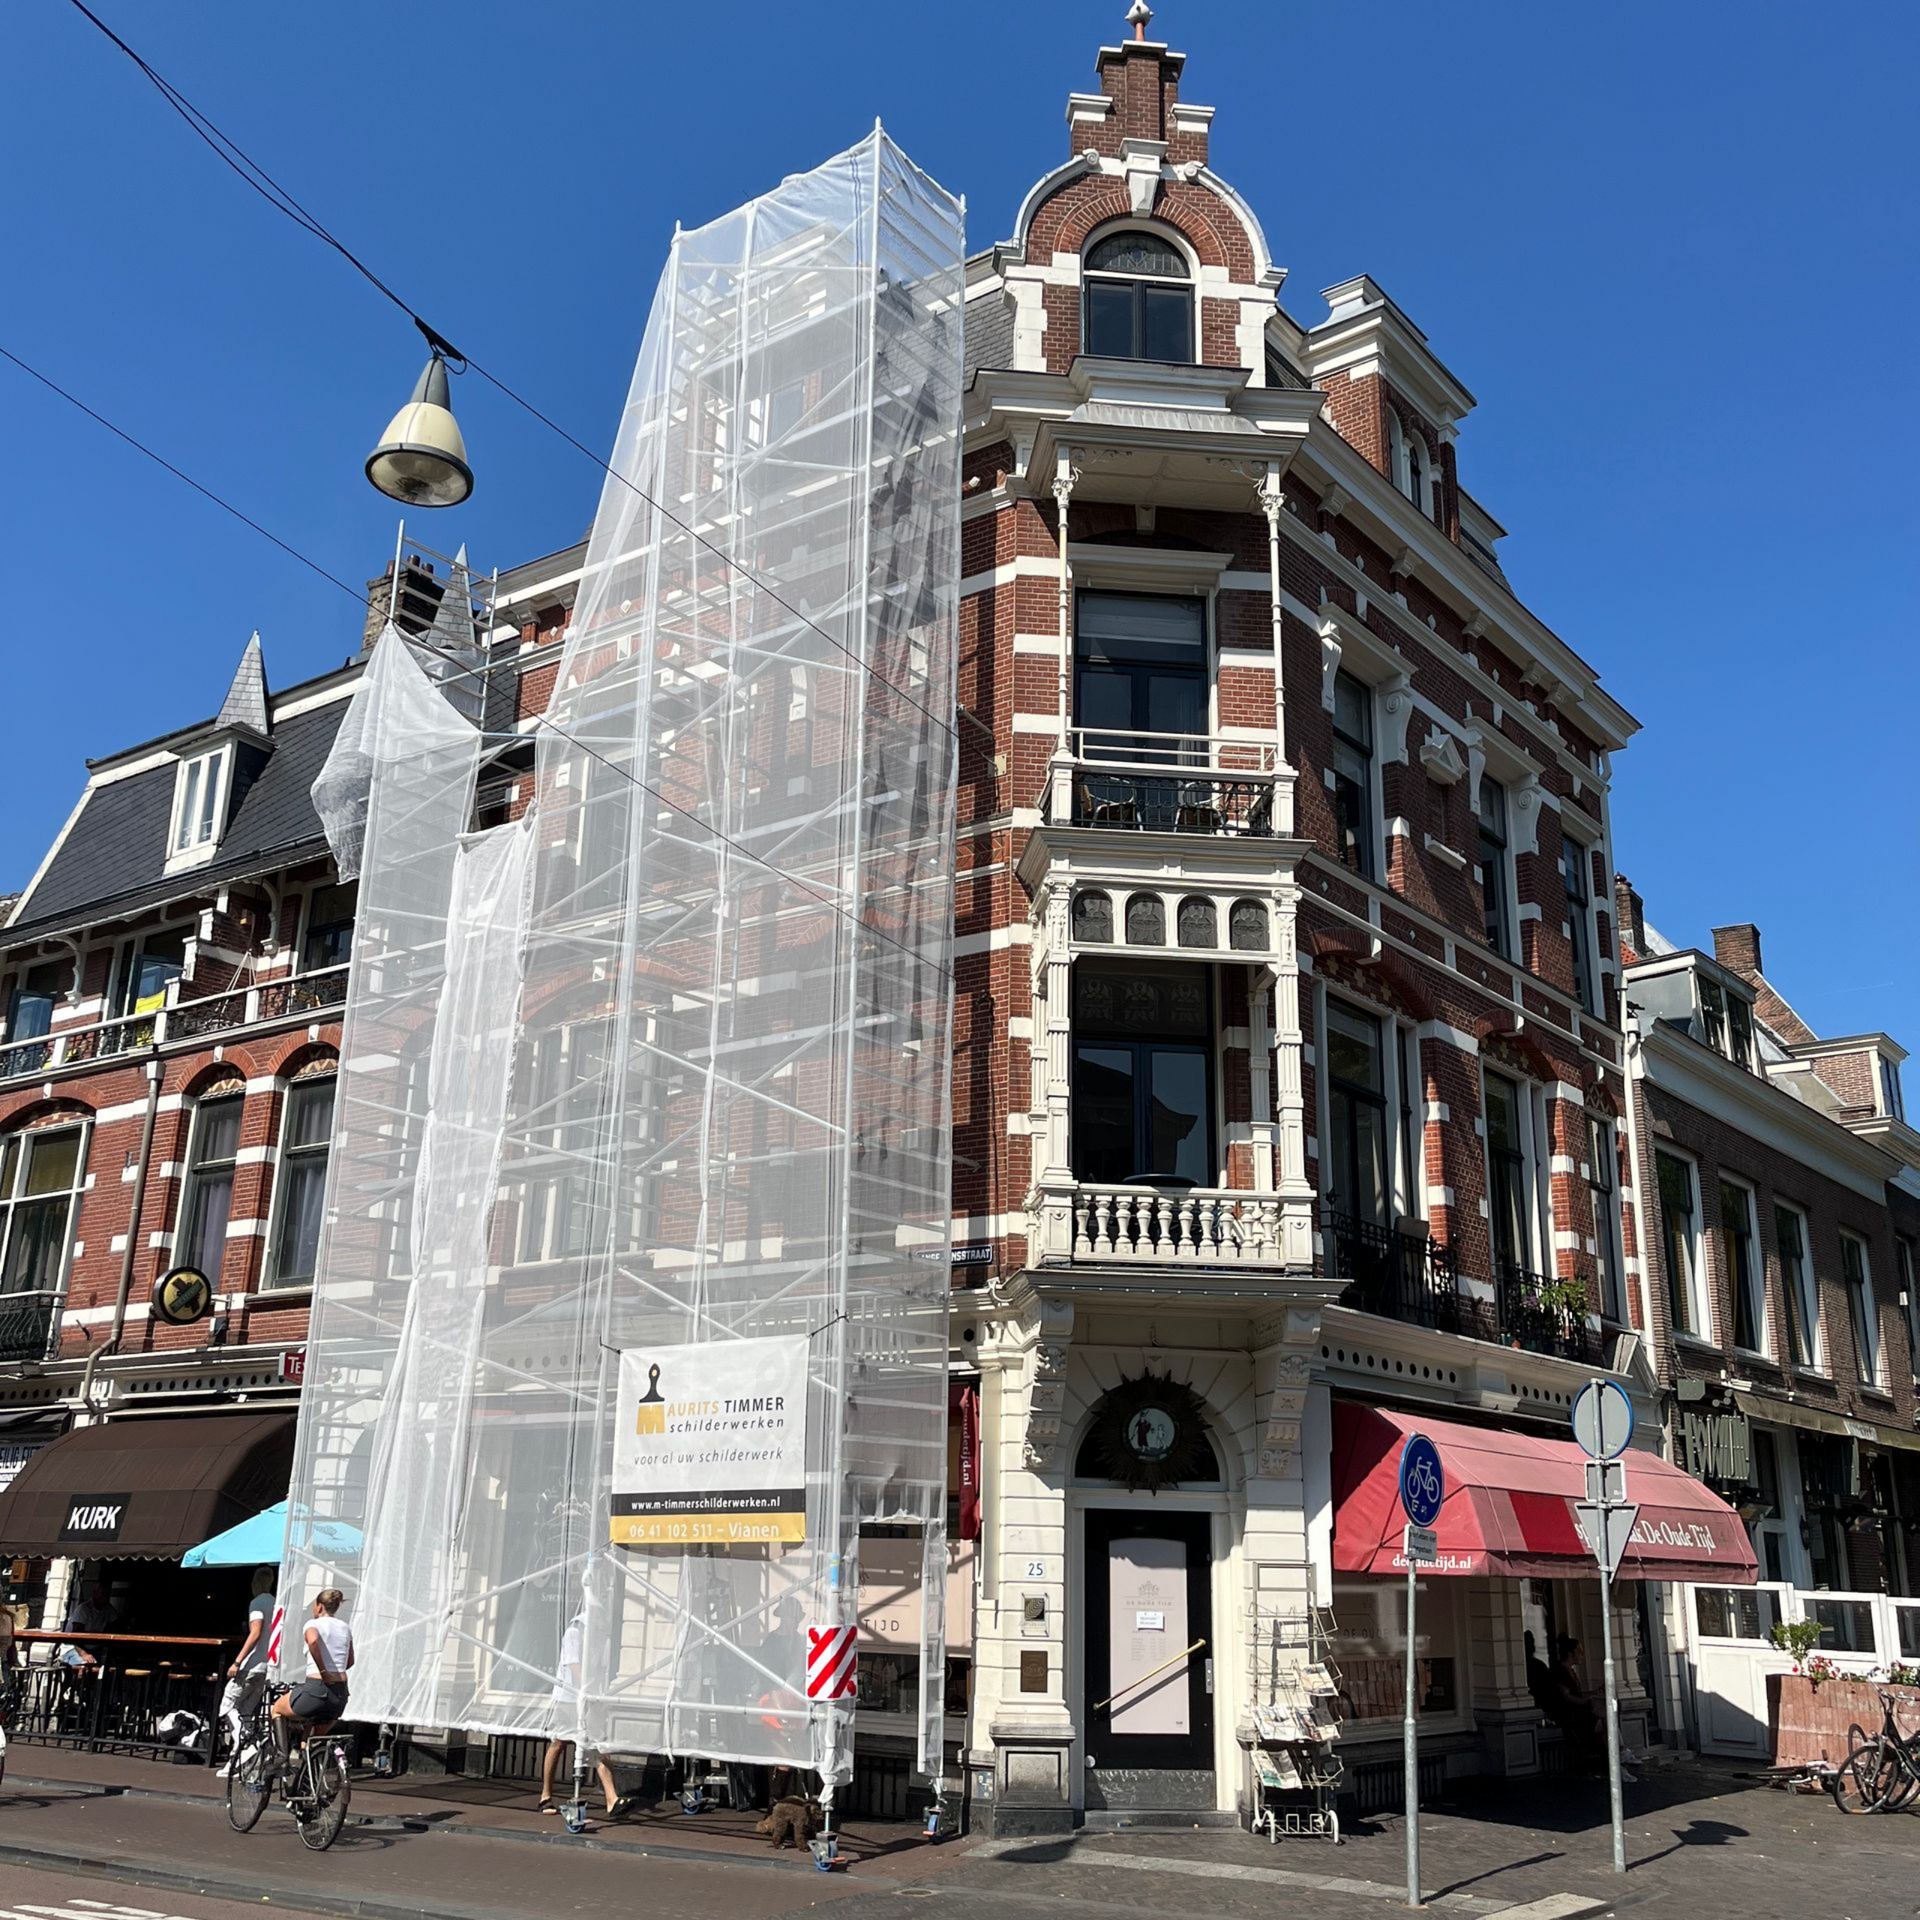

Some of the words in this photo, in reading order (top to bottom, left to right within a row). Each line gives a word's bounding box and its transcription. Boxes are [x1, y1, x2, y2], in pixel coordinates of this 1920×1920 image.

[725, 1396, 784, 1413] TIMMER
[670, 1416, 784, 1433] schilderwerken
[634, 1454, 658, 1466] voor
[662, 1451, 673, 1465] al
[677, 1452, 695, 1463] uw
[699, 1446, 783, 1463] schilderwerk
[631, 1496, 781, 1510] www.m-timmerschilderwerken.nl
[67, 1505, 122, 1530] KURK
[630, 1523, 645, 1538] 06
[649, 1523, 661, 1537] 41
[667, 1523, 687, 1537] 102
[692, 1522, 713, 1537] 511
[728, 1522, 780, 1537] Vianen
[1641, 1520, 1663, 1545] De
[1660, 1521, 1693, 1547] Oude
[1688, 1523, 1716, 1556] Tijd
[1028, 1562, 1044, 1576] 25
[864, 1619, 900, 1632] TIJD
